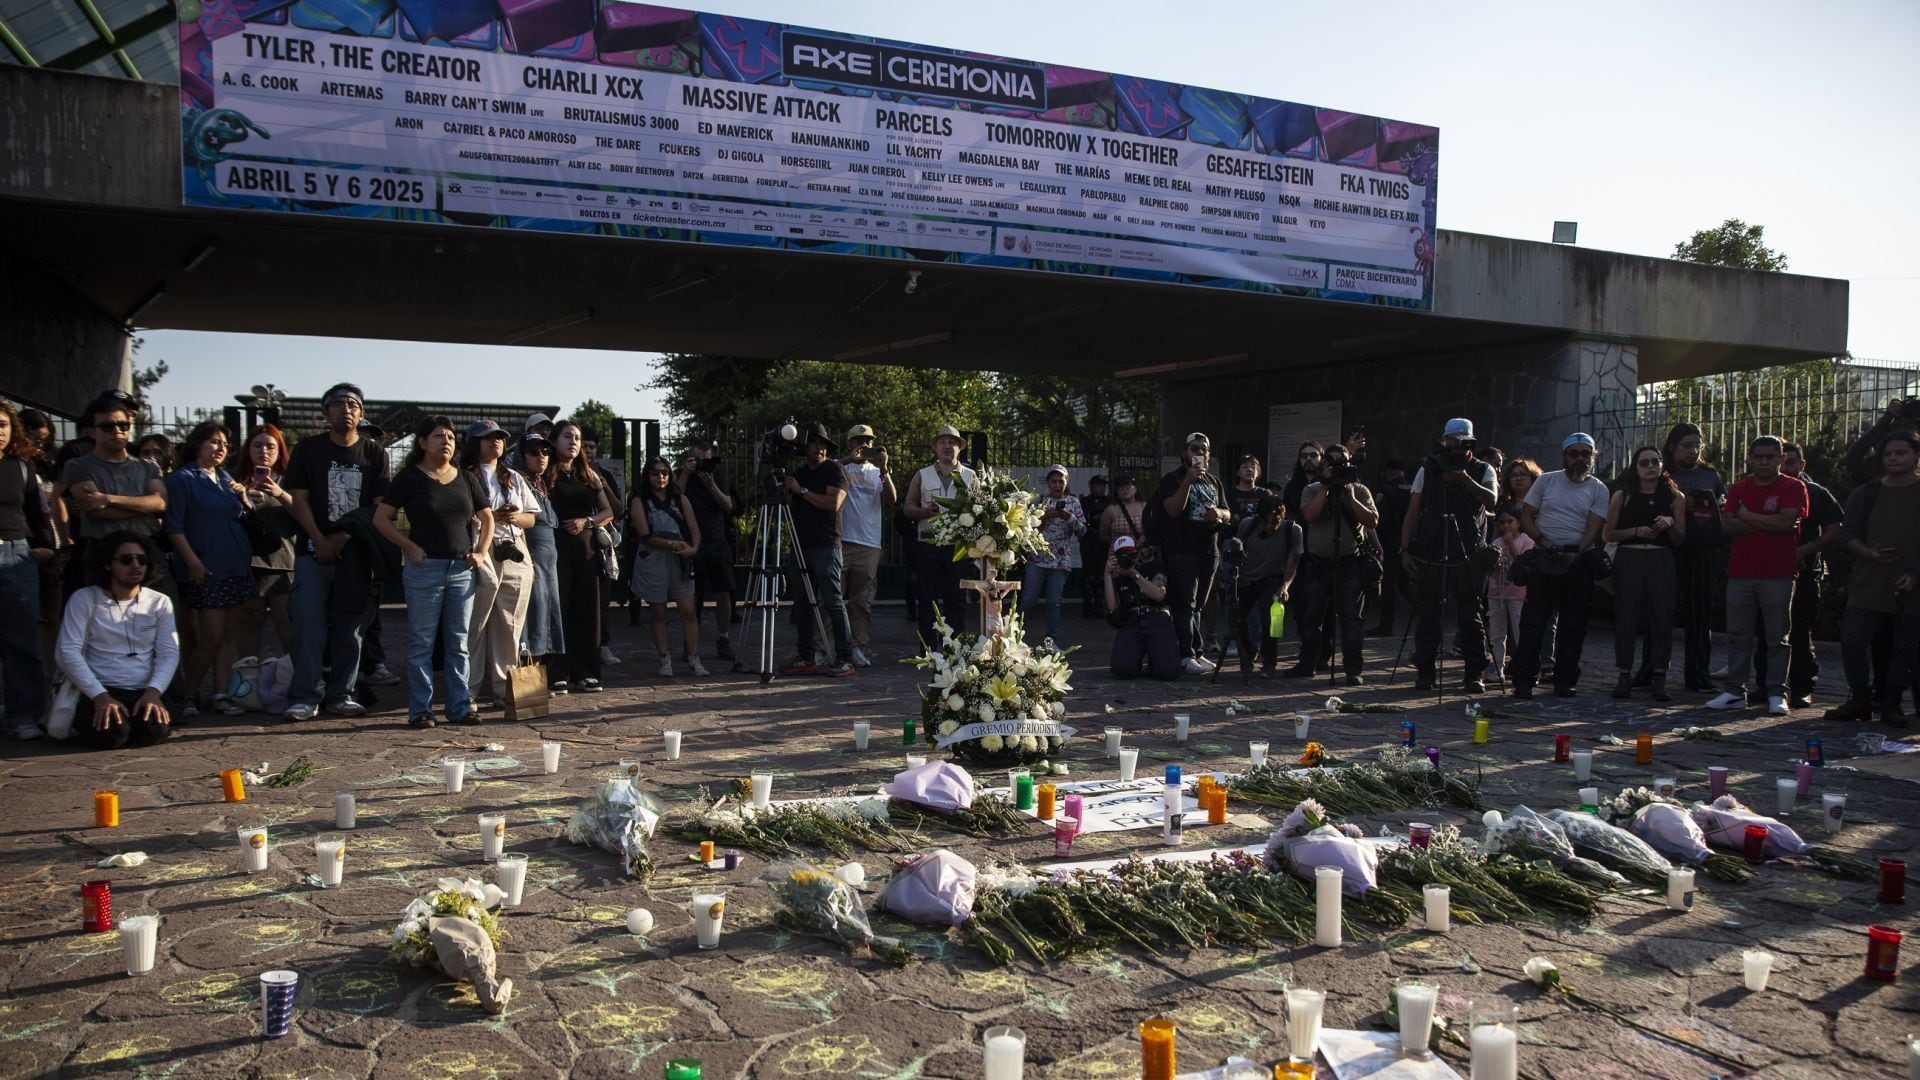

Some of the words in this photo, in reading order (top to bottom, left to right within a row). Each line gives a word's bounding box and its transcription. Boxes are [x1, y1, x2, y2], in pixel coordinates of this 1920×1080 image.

[793, 44, 872, 76] AXE
[887, 55, 1037, 100] CEREMONIA
[329, 43, 372, 70] THE
[381, 49, 480, 82] CREATOR
[523, 66, 596, 94] CHARLI
[604, 75, 643, 100] XCX
[683, 84, 767, 114] MASSIVE
[773, 96, 840, 123] ATTACK
[876, 108, 952, 136] PARCELS
[985, 122, 1081, 152] TOMORROW
[1086, 135, 1096, 154] X
[1101, 138, 1178, 166] TOGETHER
[1206, 154, 1313, 185] GESAFFELSTEIN
[1340, 173, 1364, 193] FKA
[1368, 178, 1409, 200] TWIGS
[222, 72, 236, 85] A.
[241, 73, 255, 87] G.
[260, 75, 298, 91] COOK
[320, 81, 383, 100] ARTEMAS
[405, 90, 446, 106] BARRY
[452, 95, 488, 111] CAN'T
[492, 100, 526, 115] SWIM
[564, 107, 646, 127] BRUTALISMUS
[650, 116, 678, 130] 3000
[698, 122, 712, 134] ED
[717, 124, 773, 140] MAVERICK
[791, 132, 869, 151] HANUMANKIND
[887, 143, 901, 155] LIL
[904, 145, 942, 160] YACHTY
[958, 151, 1018, 168] MAGDALENA
[1022, 158, 1039, 170] BAY
[1055, 162, 1072, 175] THE
[1075, 165, 1110, 180] MARÍAS
[1124, 172, 1150, 186] MEME
[1153, 176, 1168, 188] DEL
[1171, 179, 1192, 192] REAL
[1205, 184, 1231, 197] NATHY
[1234, 188, 1265, 202] PELUSO
[1278, 194, 1300, 207] NSQK
[1313, 198, 1340, 212] RICHIE
[1342, 203, 1370, 216] HAWTIN
[1372, 207, 1388, 218] DEX
[1390, 210, 1404, 221] EFX
[1405, 211, 1419, 223] XOX
[227, 166, 296, 193] ABRIL
[304, 172, 318, 195] 5
[325, 174, 339, 196] Y
[347, 176, 361, 198] 6
[369, 178, 424, 203] 2025
[395, 117, 422, 129] ARON
[444, 122, 484, 136] CA7RIEL
[488, 126, 496, 136] &
[499, 127, 524, 139] PACO
[528, 130, 576, 144] AMOROSO
[595, 136, 612, 148] THE
[616, 138, 640, 150] DARE
[659, 143, 700, 156] FCUKERS
[718, 149, 728, 159] DJ
[731, 150, 763, 162] GIGOLA
[781, 155, 831, 169] HORSEGIIRL
[848, 163, 868, 173] JUAN
[872, 165, 906, 178] CIREROL
[922, 170, 945, 181] KELLY
[948, 173, 962, 183] LEE
[965, 175, 992, 186] OWENS
[1020, 181, 1066, 195] LEGALLYRXX
[1080, 188, 1126, 202] PABLOPABLO
[1139, 196, 1168, 208] RALPHIE
[1170, 201, 1188, 211] CHOO
[1201, 205, 1231, 217] SIMPSON
[1233, 209, 1259, 220] AHUEVO
[1272, 214, 1297, 225] VALGUR
[1309, 219, 1325, 229] YEYO
[568, 160, 585, 169] ALBY
[587, 162, 601, 170] ESC
[610, 164, 633, 173] BOBBY
[635, 166, 674, 176] BEETHOVEN
[683, 170, 704, 180] DAY2K
[712, 174, 748, 184] DERRETIDA
[756, 178, 787, 187] FOREPLAY
[891, 191, 904, 199] JOSÉ
[906, 193, 934, 202] EDUARDO
[936, 196, 962, 205] BARAJAS
[970, 199, 986, 207] LUISA
[988, 201, 1018, 210] ALMAGUER
[1026, 205, 1054, 215] MAGNOLIA
[1056, 208, 1086, 217] CORONADO
[499, 188, 527, 197] Banamex
[579, 209, 610, 219] BOLETOS
[612, 211, 621, 220] EN
[632, 212, 727, 228] ticketmaster.com.mx
[1335, 267, 1365, 280] PARQUE
[1367, 271, 1418, 287] BICENTENARIO
[1335, 278, 1356, 289] CDMX
[971, 722, 1014, 737] GREMIO
